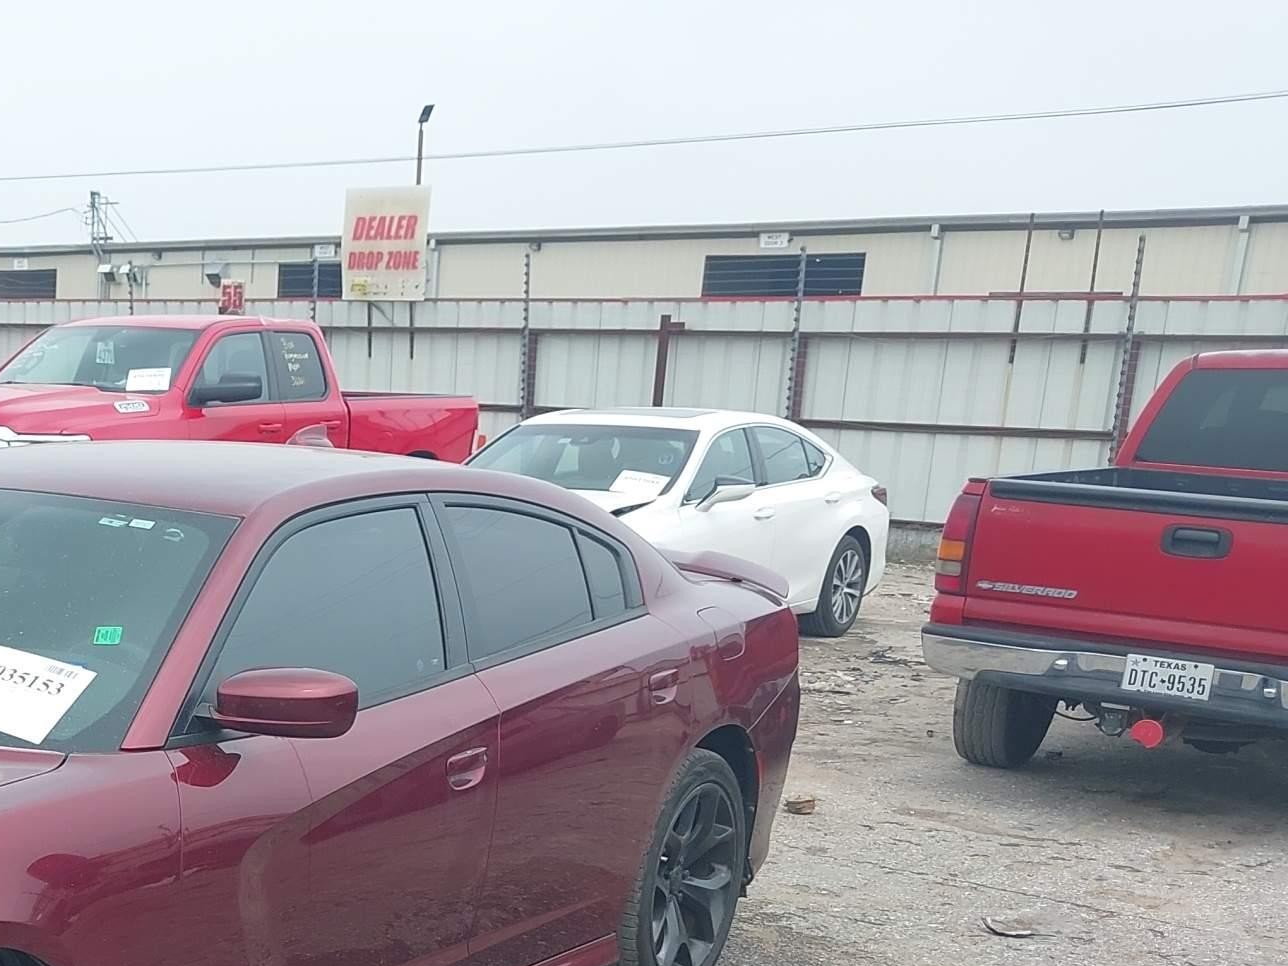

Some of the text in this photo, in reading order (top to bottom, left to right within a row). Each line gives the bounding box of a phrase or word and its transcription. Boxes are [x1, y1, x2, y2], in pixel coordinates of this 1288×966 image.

[352, 214, 418, 242] DEALER
[347, 251, 384, 271] DROP
[385, 250, 420, 271] ZONE
[992, 582, 1078, 599] SILVERADO
[1153, 660, 1187, 671] TEXAS
